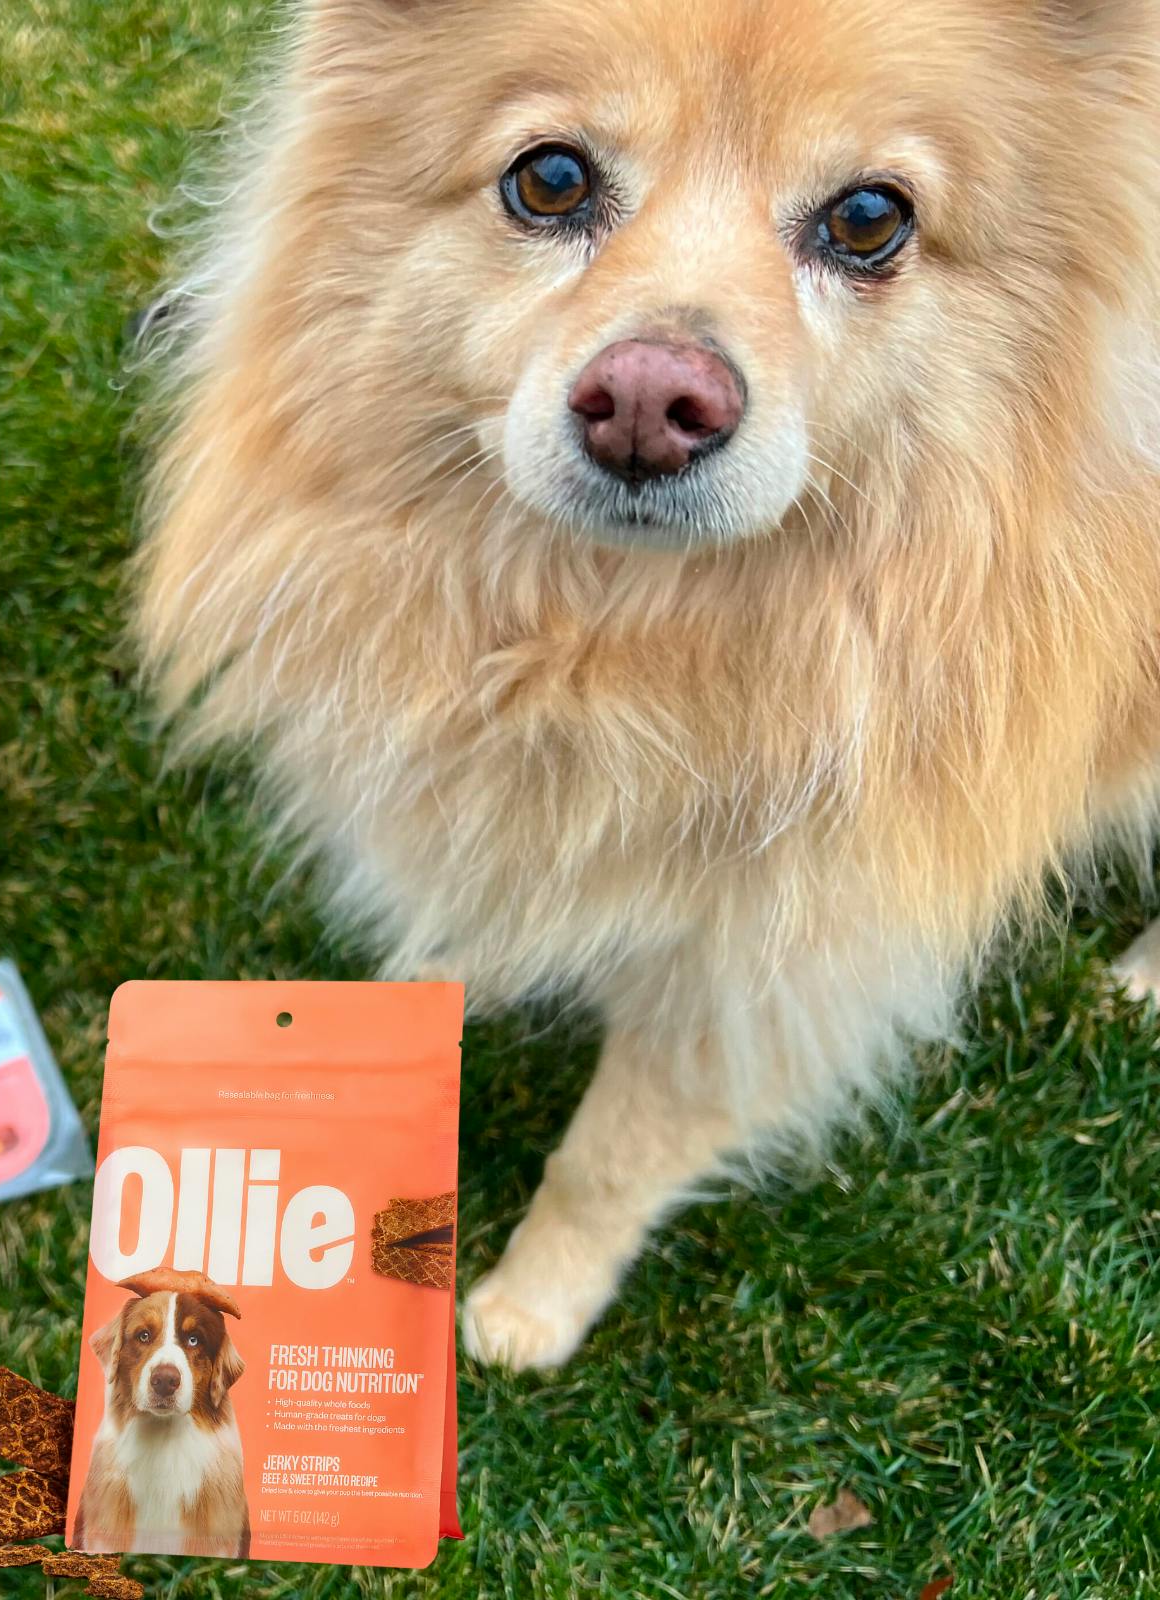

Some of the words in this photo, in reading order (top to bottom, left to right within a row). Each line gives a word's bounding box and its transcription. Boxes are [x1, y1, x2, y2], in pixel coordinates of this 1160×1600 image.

[89, 1145, 355, 1290] Ollie
[270, 1344, 318, 1366] FRESH
[322, 1346, 394, 1368] THINKING
[268, 1369, 297, 1390] FOR
[301, 1371, 332, 1392] DOG
[275, 1398, 322, 1409] High-quality
[324, 1400, 347, 1409] whole
[348, 1400, 371, 1410] foods
[274, 1410, 329, 1421] Human-grade
[330, 1411, 353, 1421] treats
[354, 1412, 366, 1421] for
[367, 1413, 386, 1424] dogs
[273, 1421, 296, 1431] Made
[296, 1422, 313, 1431] with
[362, 1424, 405, 1435] ingredients
[263, 1455, 299, 1471] JERKY
[301, 1456, 340, 1472] STRIPS
[262, 1472, 281, 1485] BEEF
[282, 1474, 288, 1485] &
[289, 1473, 316, 1486] SWEET
[317, 1474, 350, 1487] POTATO
[351, 1476, 378, 1488] RECIPE
[260, 1509, 277, 1523] NET
[278, 1510, 292, 1523] WT
[300, 1511, 312, 1524] OZ
[313, 1511, 330, 1526] (142
[330, 1511, 340, 1528] g)
